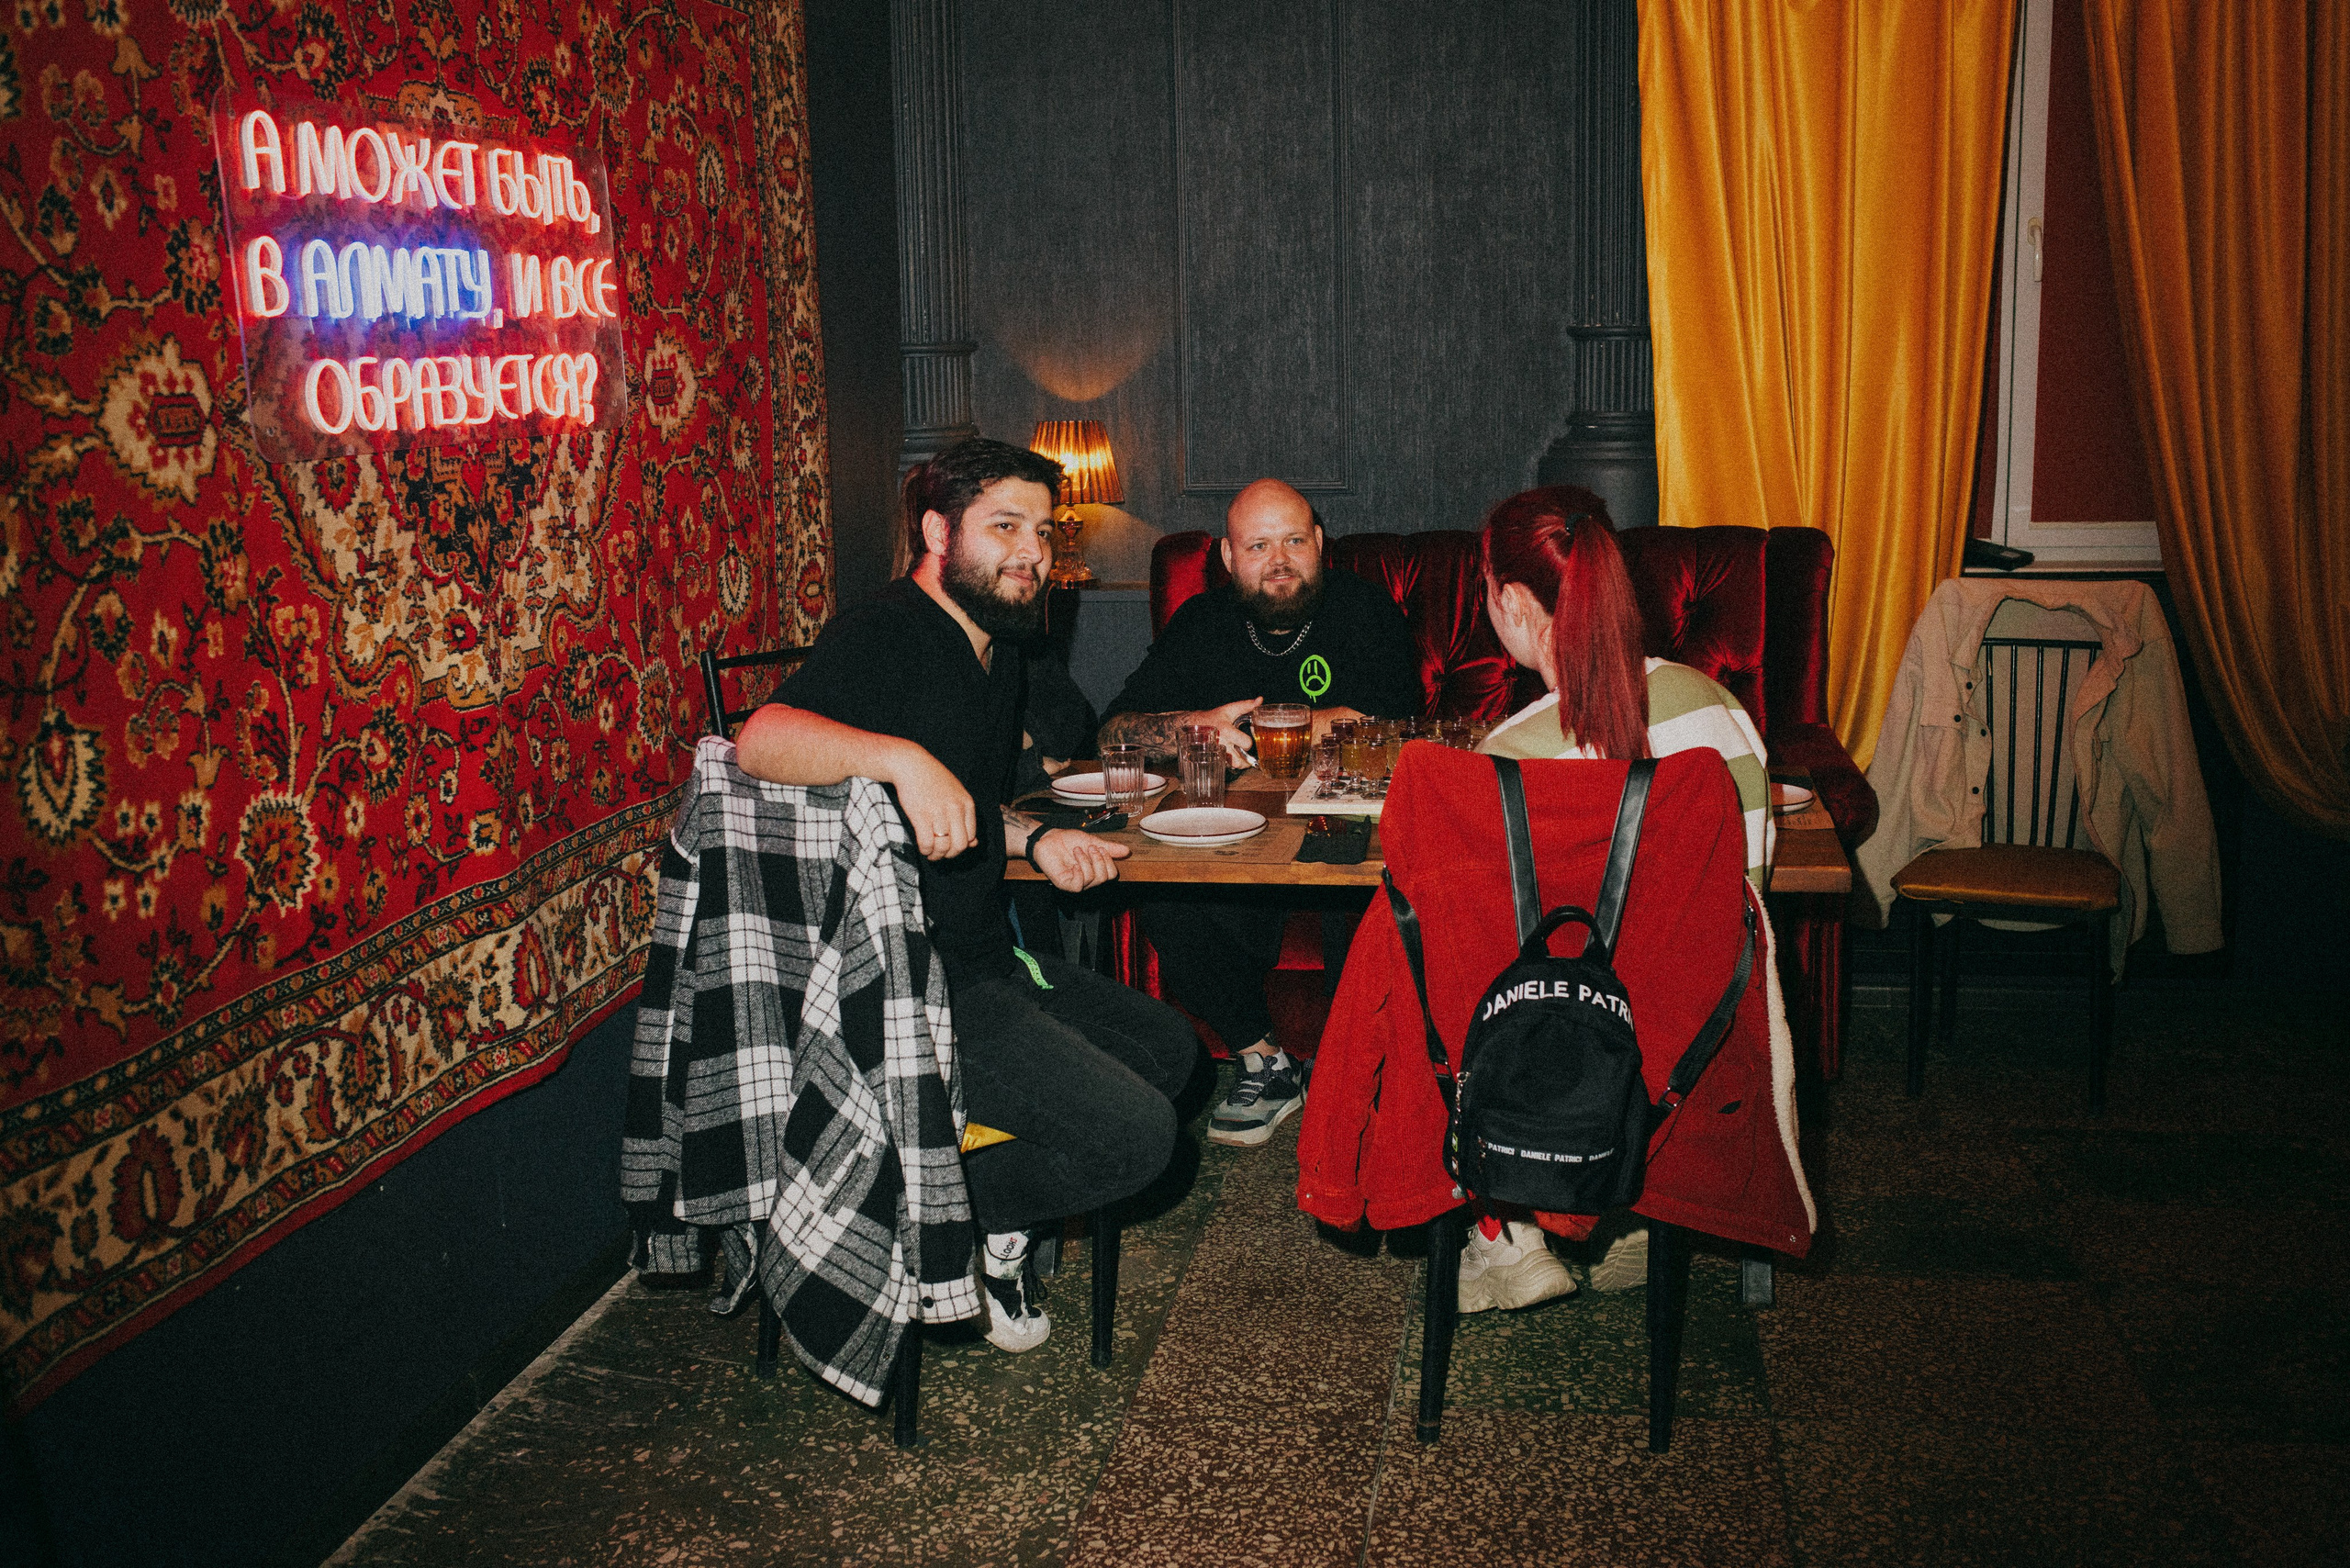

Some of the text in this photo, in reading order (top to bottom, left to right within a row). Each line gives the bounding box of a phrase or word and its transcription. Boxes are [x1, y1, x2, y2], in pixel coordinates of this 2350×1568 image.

[241, 110, 600, 234] А МОЖЕТ БЫТЬ,
[247, 235, 290, 318] В
[509, 252, 543, 319] И
[550, 255, 617, 319] ВСЕ
[305, 352, 598, 435] ОБРАЗУЕТСЯ?
[1487, 1141, 1516, 1156] PATRICI
[1520, 1149, 1551, 1162] DANIELE
[1554, 1153, 1583, 1163] PATRICI
